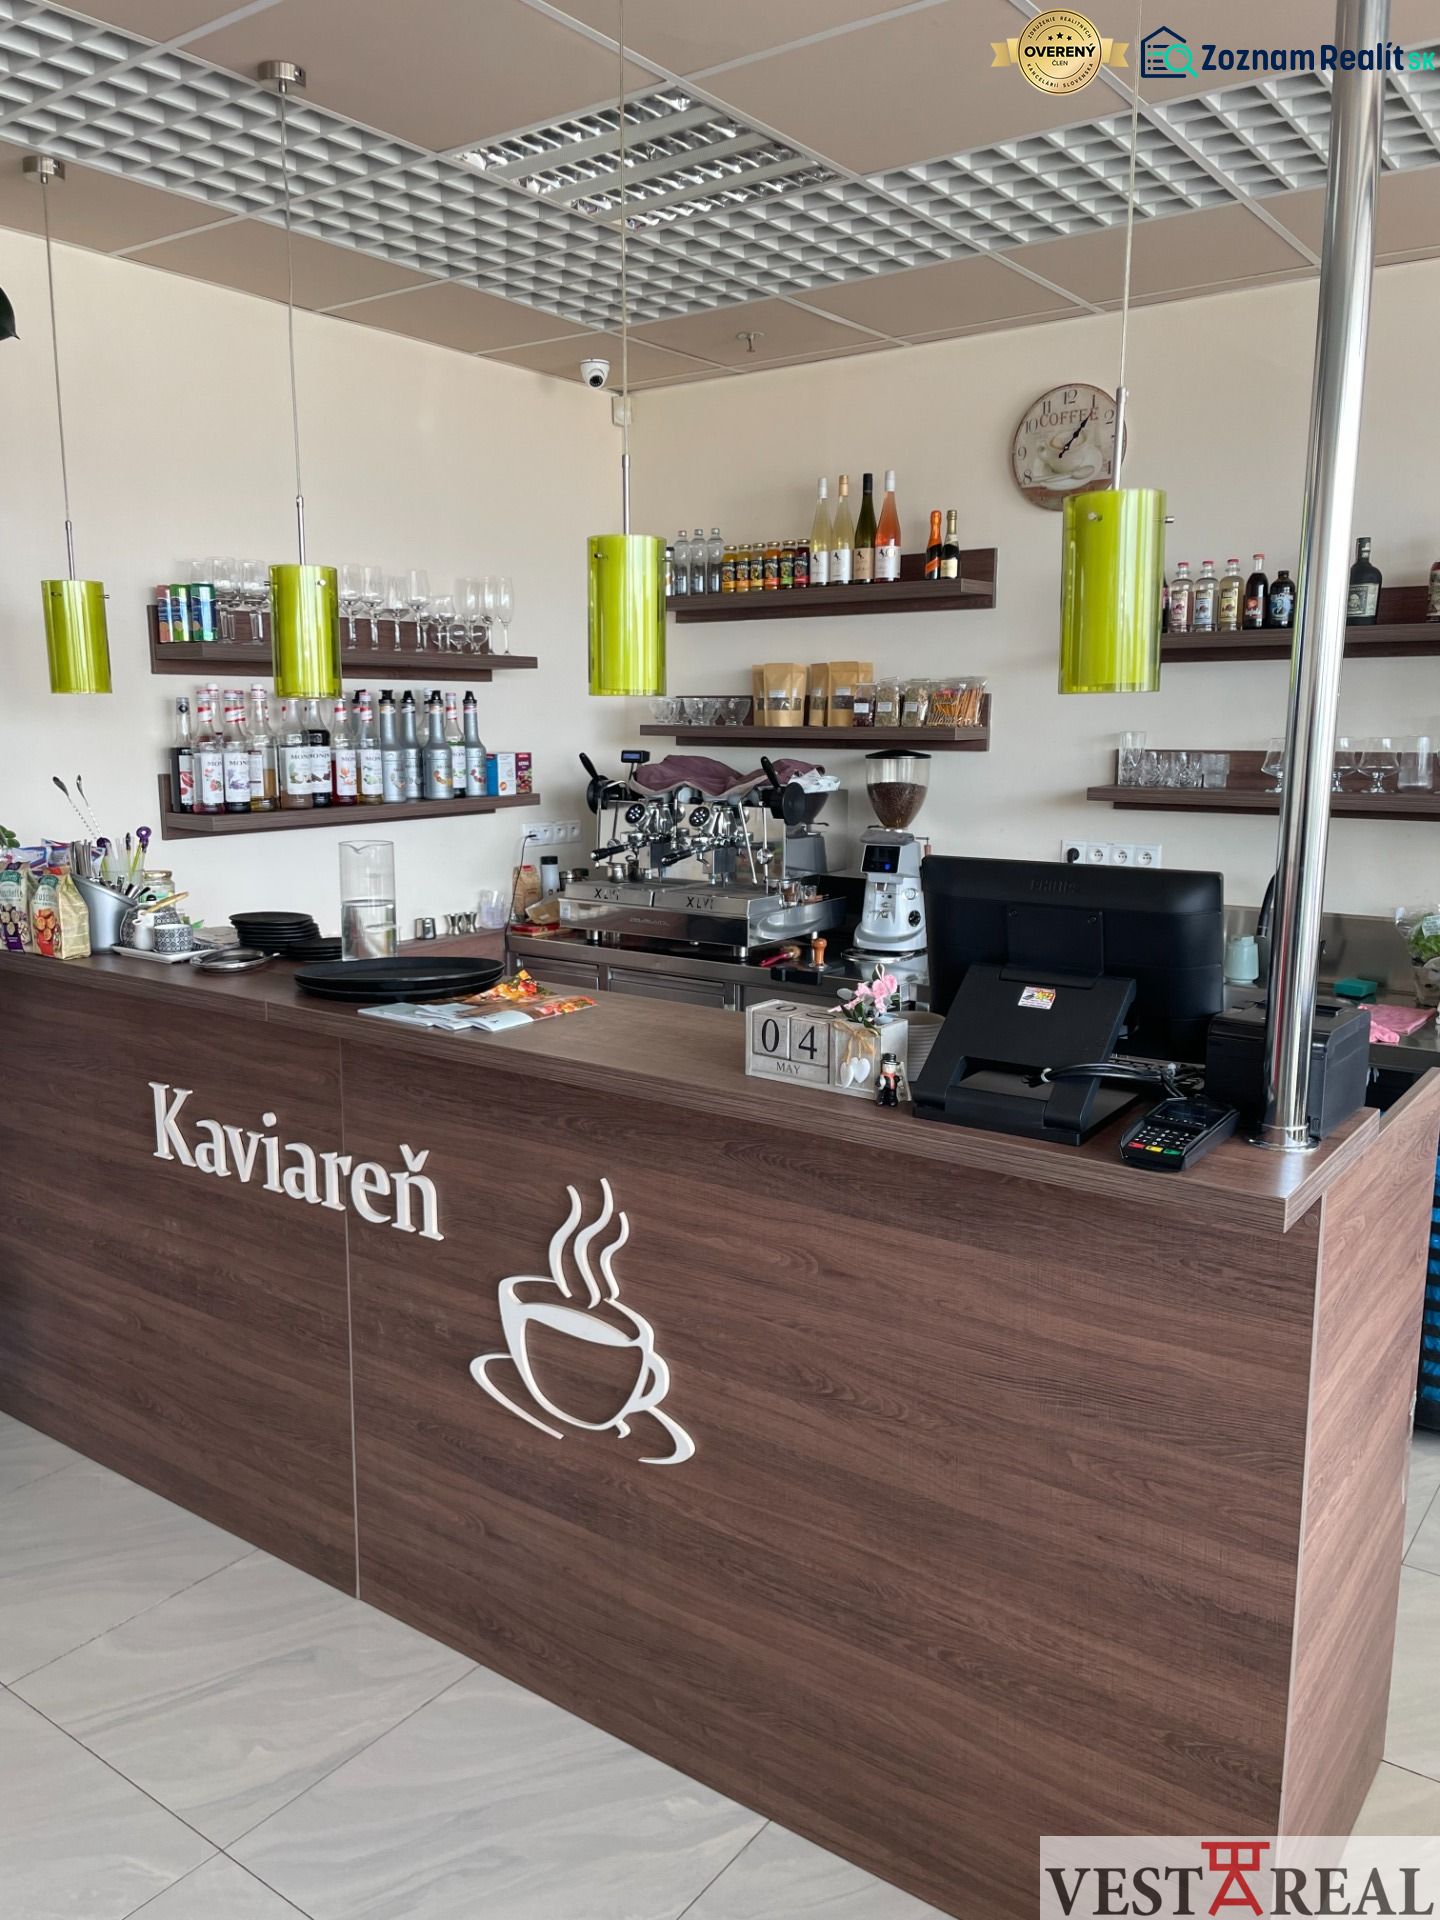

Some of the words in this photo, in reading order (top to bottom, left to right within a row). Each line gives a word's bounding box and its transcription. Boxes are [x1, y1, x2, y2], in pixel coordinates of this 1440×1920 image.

[1063, 389, 1078, 405] 12
[1042, 400, 1052, 414] 11
[1039, 406, 1099, 427] COFFEE
[1104, 408, 1115, 425] 2
[1025, 420, 1039, 433] 10
[1018, 446, 1027, 459] 9
[1022, 468, 1033, 485] 8
[686, 896, 714, 910] XLVI
[761, 1018, 780, 1053] 0
[798, 1025, 818, 1060] 4
[776, 1061, 801, 1075] MAY
[148, 1081, 445, 1241] Kaviareň
